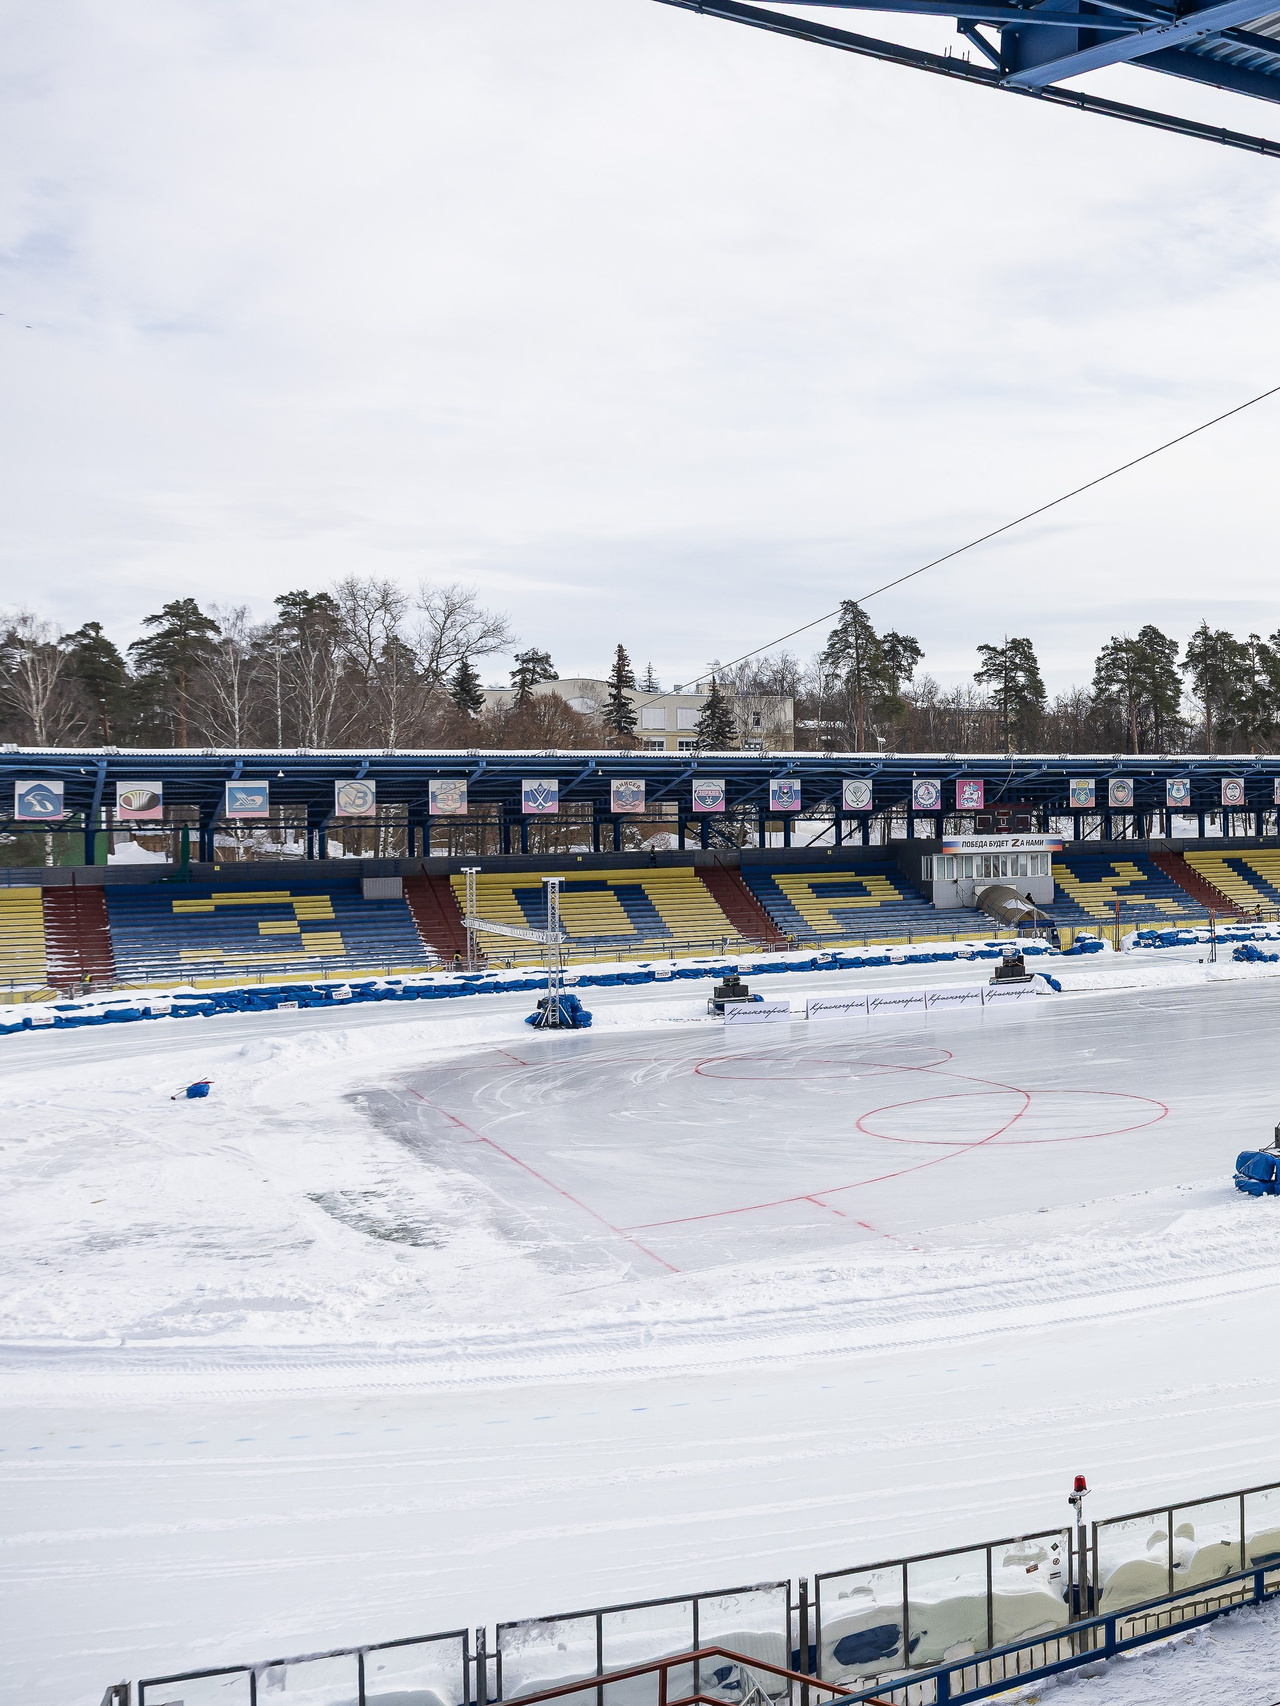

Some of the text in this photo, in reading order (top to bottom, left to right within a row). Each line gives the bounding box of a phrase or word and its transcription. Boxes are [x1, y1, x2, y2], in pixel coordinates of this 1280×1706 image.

[989, 840, 1009, 848] БУДЕТ
[928, 992, 980, 1005] Красногорск
[985, 988, 1035, 1001] Красногорск
[810, 1002, 865, 1015] Красногорск
[870, 997, 923, 1010] Красногорск
[727, 1007, 788, 1020] Красногорск
